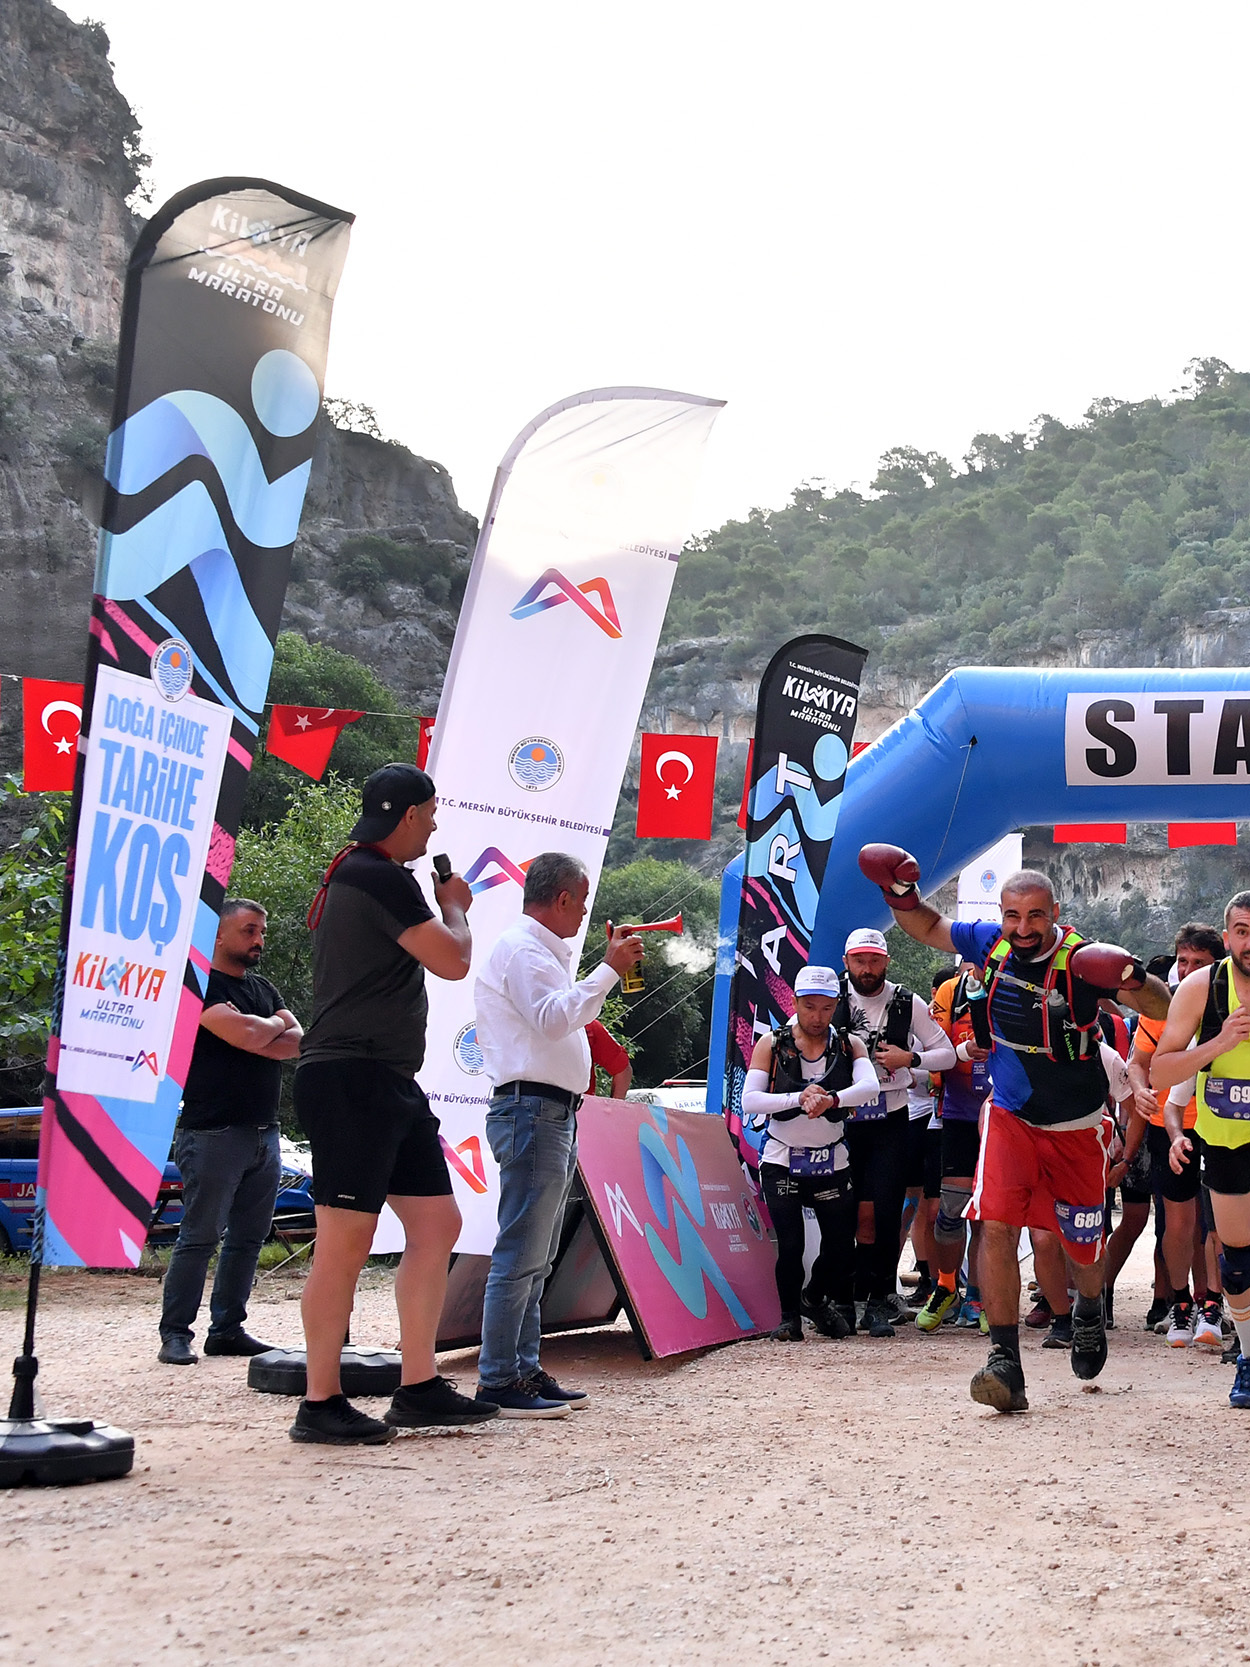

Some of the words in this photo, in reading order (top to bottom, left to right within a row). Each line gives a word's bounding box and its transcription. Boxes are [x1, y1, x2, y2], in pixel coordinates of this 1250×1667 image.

[217, 262, 283, 300] ULTRA
[188, 267, 304, 326] MARATONU
[104, 692, 154, 740] DOĞA
[790, 709, 842, 732] MARATONU
[802, 706, 832, 721] ULTRA
[441, 797, 457, 808] T.C.
[459, 801, 495, 814] MERSİN
[498, 806, 557, 825] BÜYÜKŞEHİR
[559, 819, 602, 835] BELEDİYESİ
[80, 811, 191, 956] KOŞ
[97, 999, 134, 1015] ULTRA
[80, 1009, 144, 1029] MARATONU
[426, 1091, 441, 1101] SİN
[809, 1149, 830, 1163] 729
[17, 1183, 36, 1197] JA
[1074, 1210, 1102, 1228] 680
